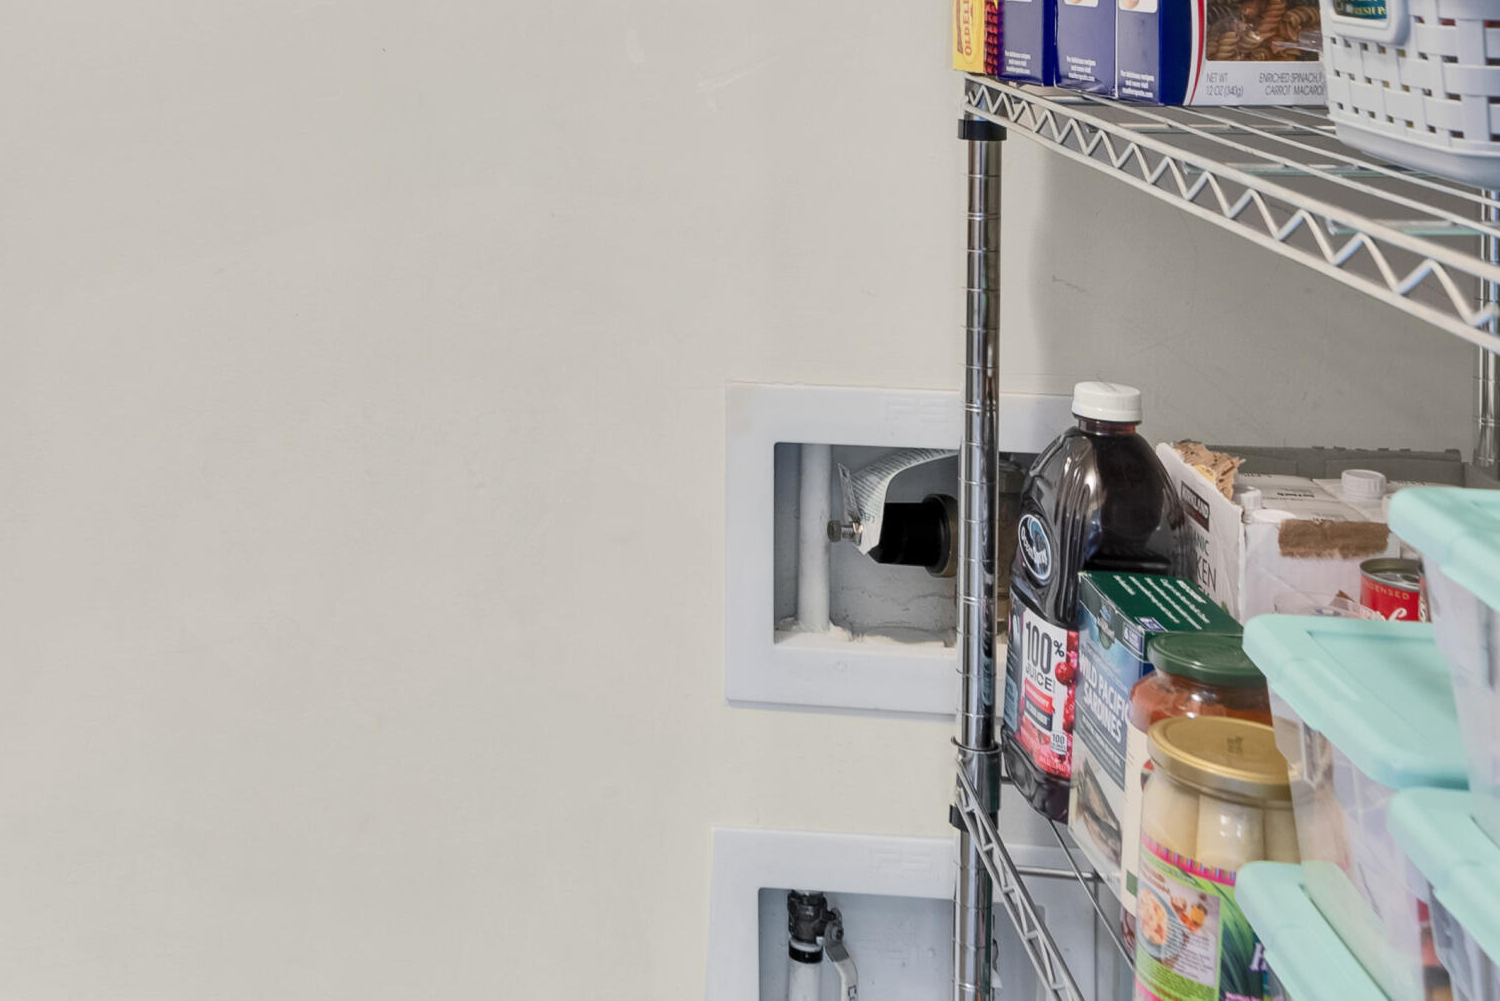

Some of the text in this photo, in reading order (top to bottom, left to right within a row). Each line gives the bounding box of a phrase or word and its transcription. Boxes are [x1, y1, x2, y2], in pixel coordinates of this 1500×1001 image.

[963, 7, 973, 26] EL
[963, 27, 973, 56] OLD
[1206, 72, 1228, 83] NET WT
[1259, 72, 1289, 83] ENRICHED
[1206, 85, 1244, 98] 12 OZ (340g)
[1265, 85, 1291, 96] CARROT
[1024, 666, 1053, 692] JUICE
[1078, 655, 1098, 688] WILD
[1099, 679, 1130, 726] PACIFIC
[1083, 683, 1122, 744] SARDINES
